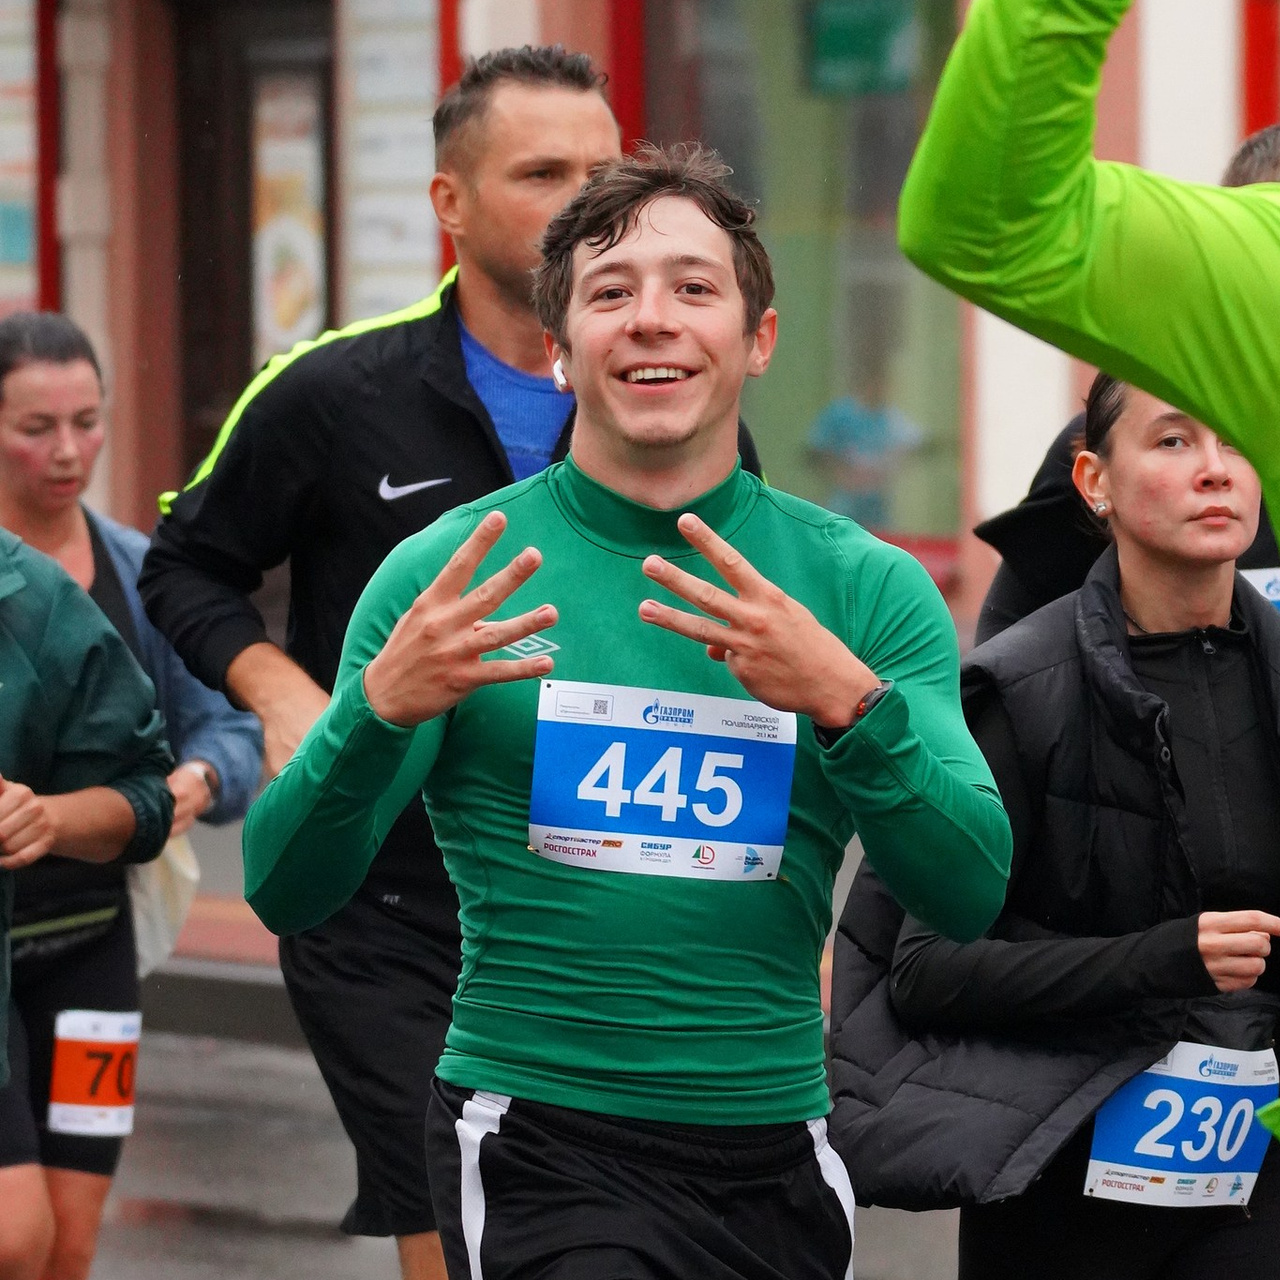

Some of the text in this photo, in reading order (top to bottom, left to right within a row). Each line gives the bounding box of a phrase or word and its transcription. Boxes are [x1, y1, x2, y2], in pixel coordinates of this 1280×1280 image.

[576, 741, 745, 828] 445
[543, 842, 597, 858] РОСГОССТРАХ
[602, 839, 623, 848] PRO
[1133, 1088, 1254, 1162] 230
[1101, 1178, 1145, 1192] РОСГОССТРАХ
